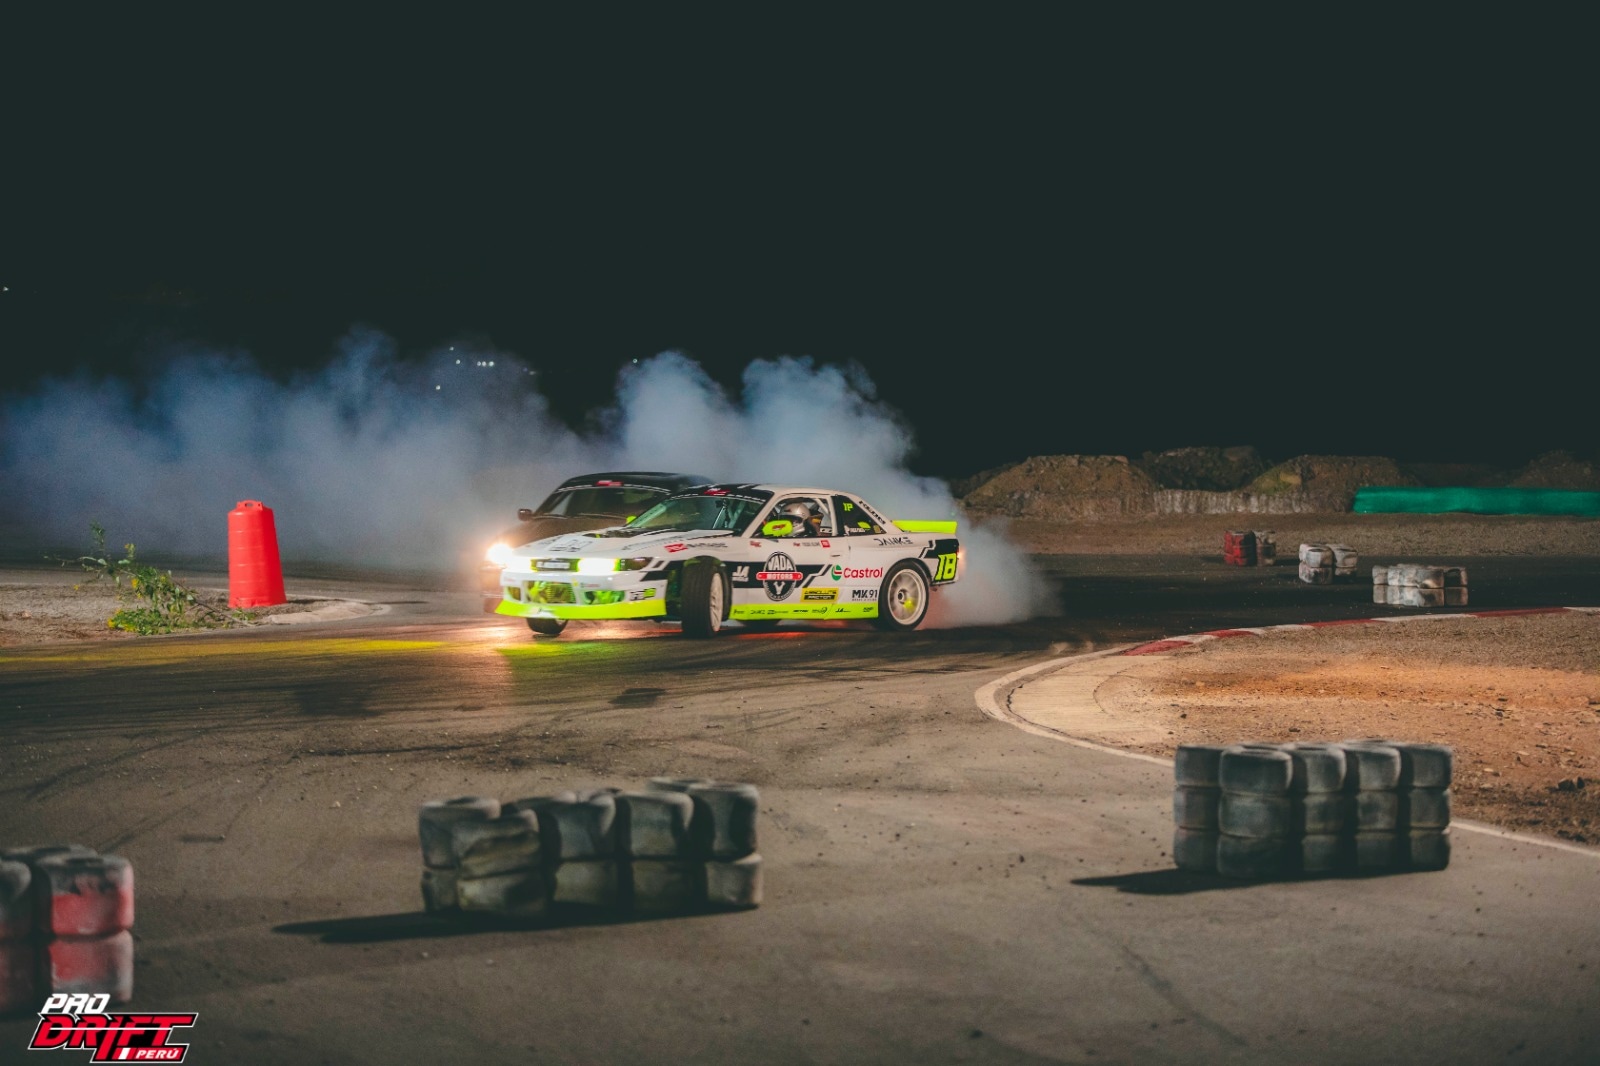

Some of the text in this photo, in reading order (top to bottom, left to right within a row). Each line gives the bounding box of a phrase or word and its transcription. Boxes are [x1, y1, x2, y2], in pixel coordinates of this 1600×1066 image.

[767, 555, 794, 571] VADA
[934, 552, 957, 582] 18
[843, 567, 883, 579] Castrol
